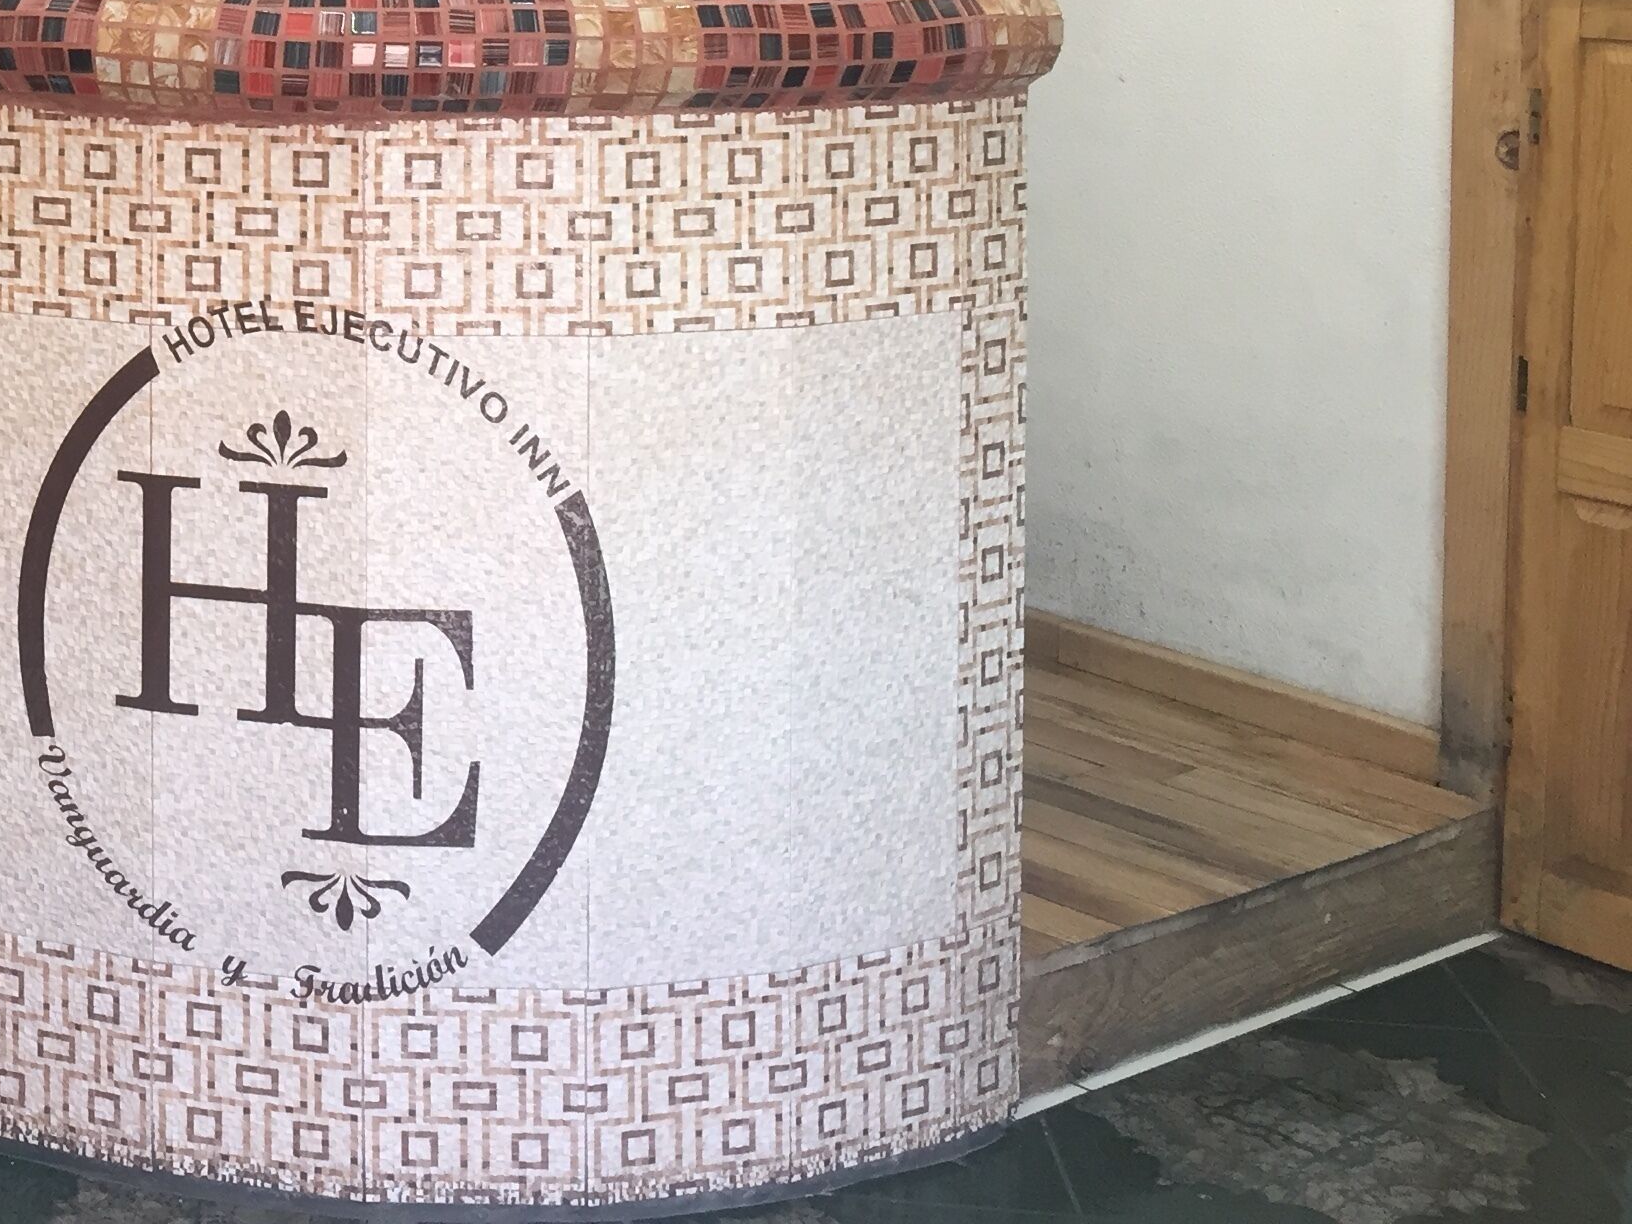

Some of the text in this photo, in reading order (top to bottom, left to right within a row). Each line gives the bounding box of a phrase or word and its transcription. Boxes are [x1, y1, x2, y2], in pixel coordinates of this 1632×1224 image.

[162, 299, 572, 499] HOTEL EJECUTIVO INN
[115, 469, 481, 849] HE
[36, 743, 470, 1004] Vanguardia y Tradición
